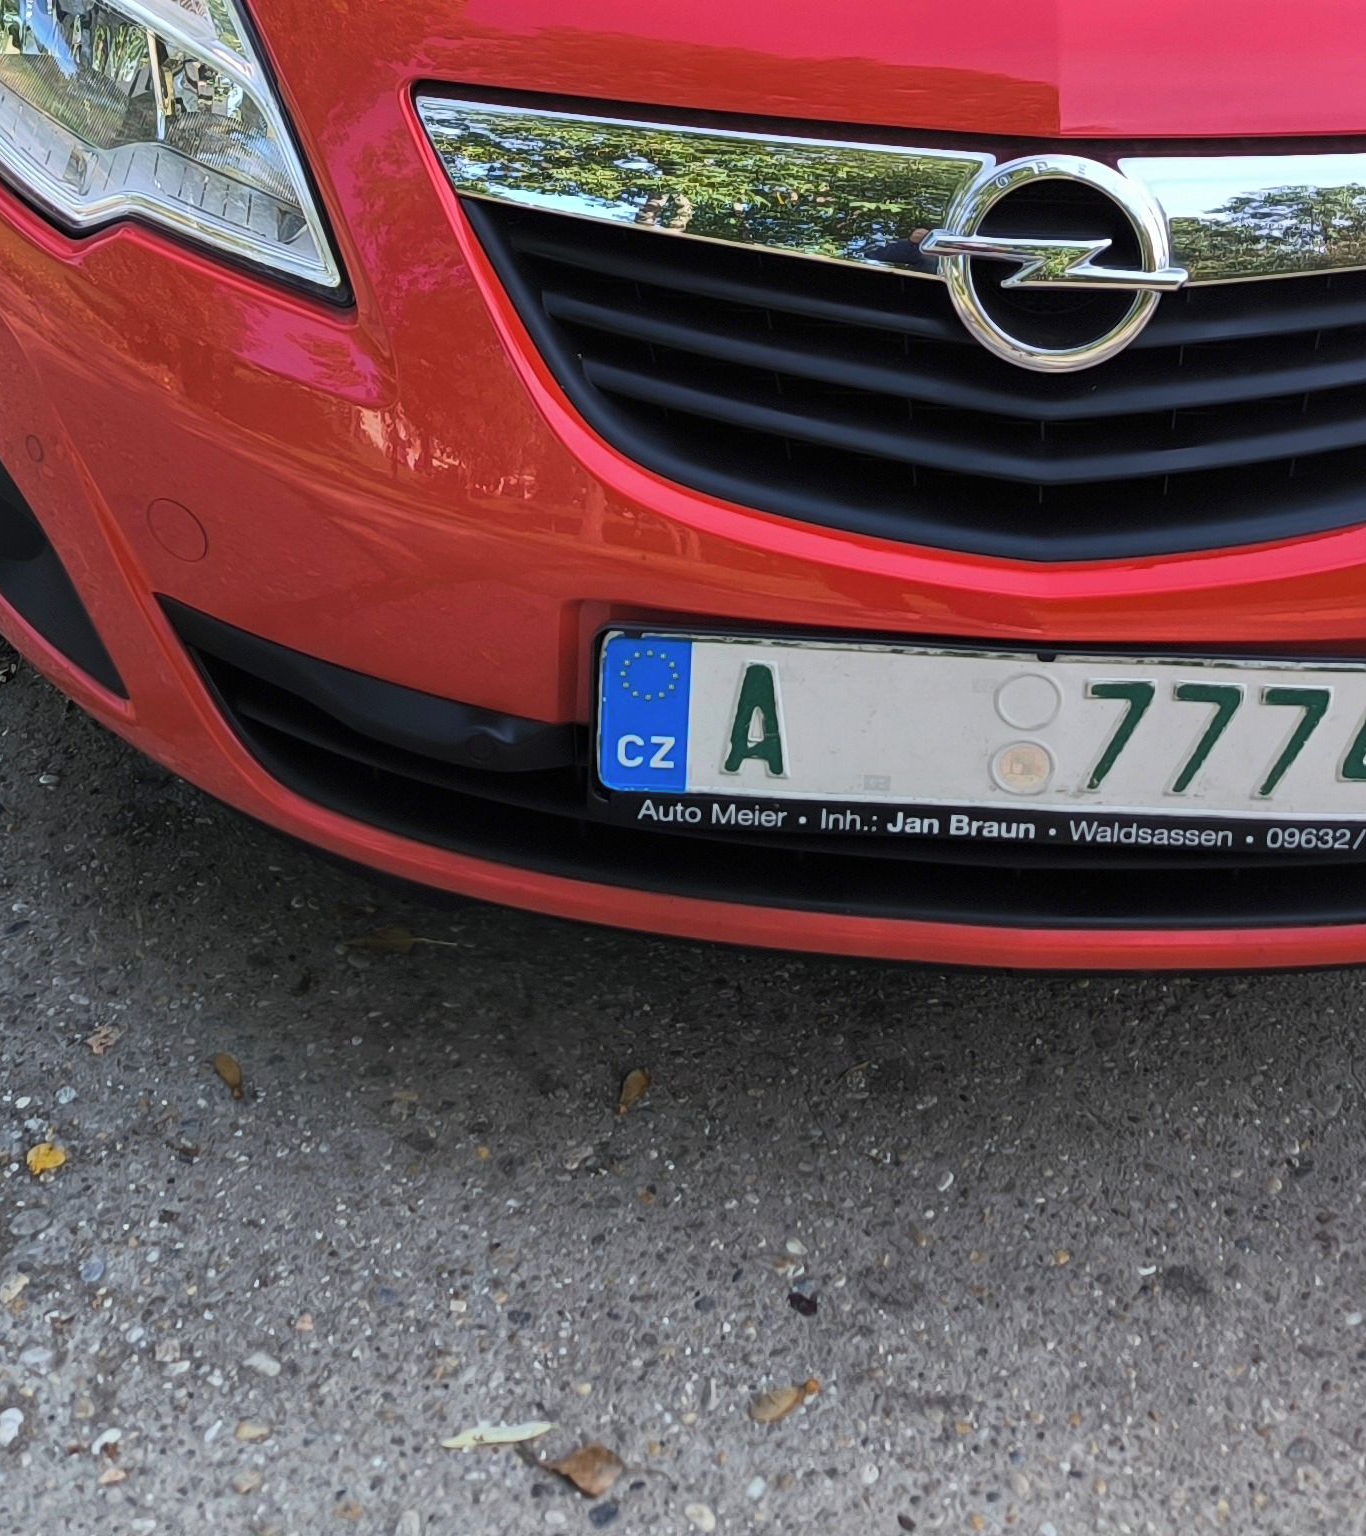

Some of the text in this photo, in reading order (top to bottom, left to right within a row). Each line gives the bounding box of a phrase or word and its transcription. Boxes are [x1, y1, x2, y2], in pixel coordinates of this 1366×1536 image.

[722, 662, 785, 777] A
[617, 734, 676, 769] CZ
[637, 799, 702, 824] Auto
[711, 803, 787, 828] Meier
[820, 808, 878, 832] Inh.:
[887, 812, 939, 835] Jan
[950, 814, 1035, 840] Braun
[1069, 820, 1233, 848] Waldsassen
